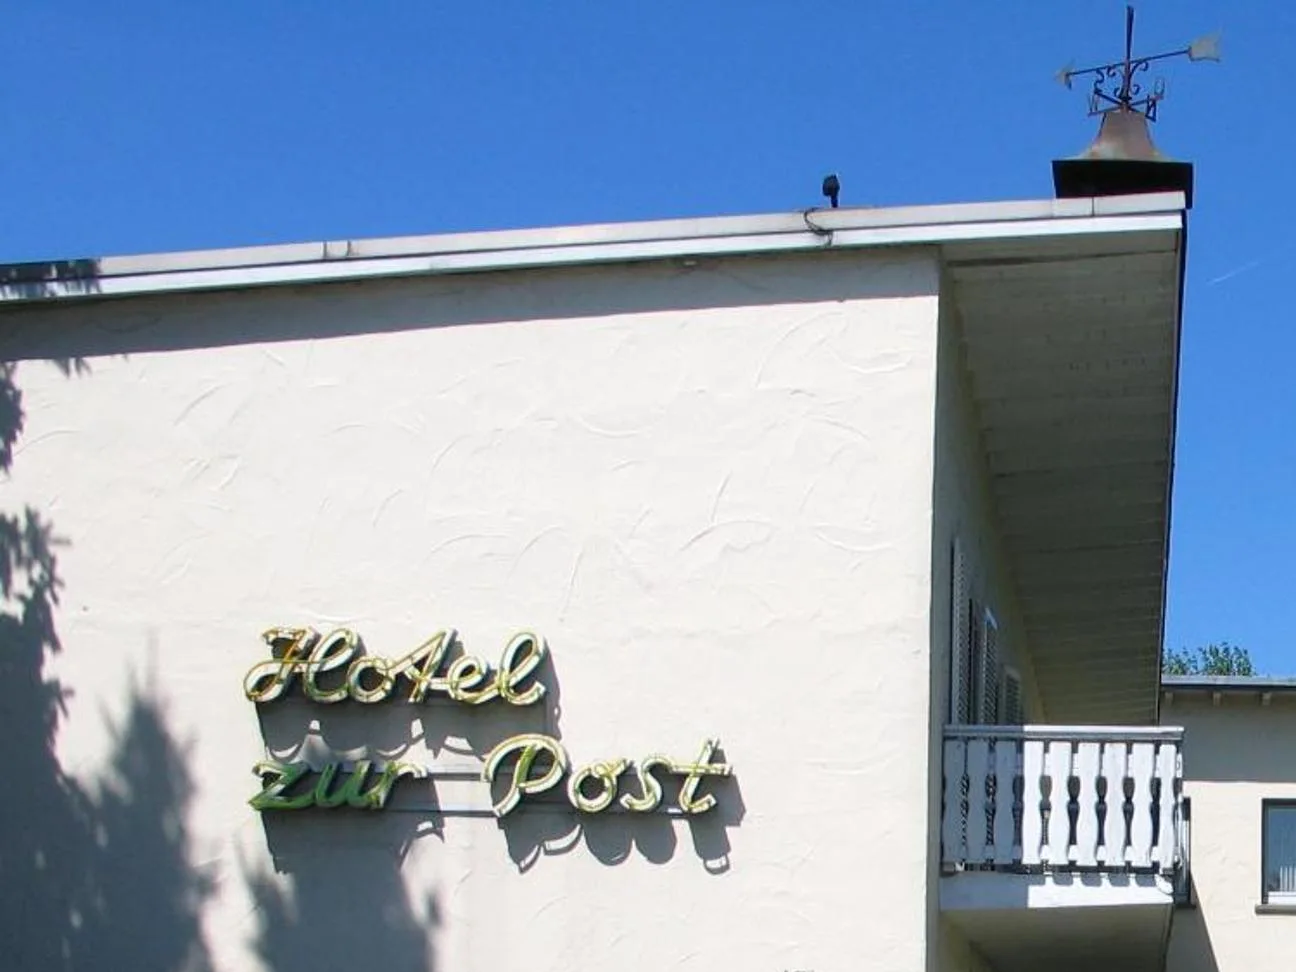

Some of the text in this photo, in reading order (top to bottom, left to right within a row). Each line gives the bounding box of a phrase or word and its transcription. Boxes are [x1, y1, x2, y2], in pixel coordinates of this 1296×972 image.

[243, 626, 546, 705] Hotel
[249, 733, 733, 816] zur Post
